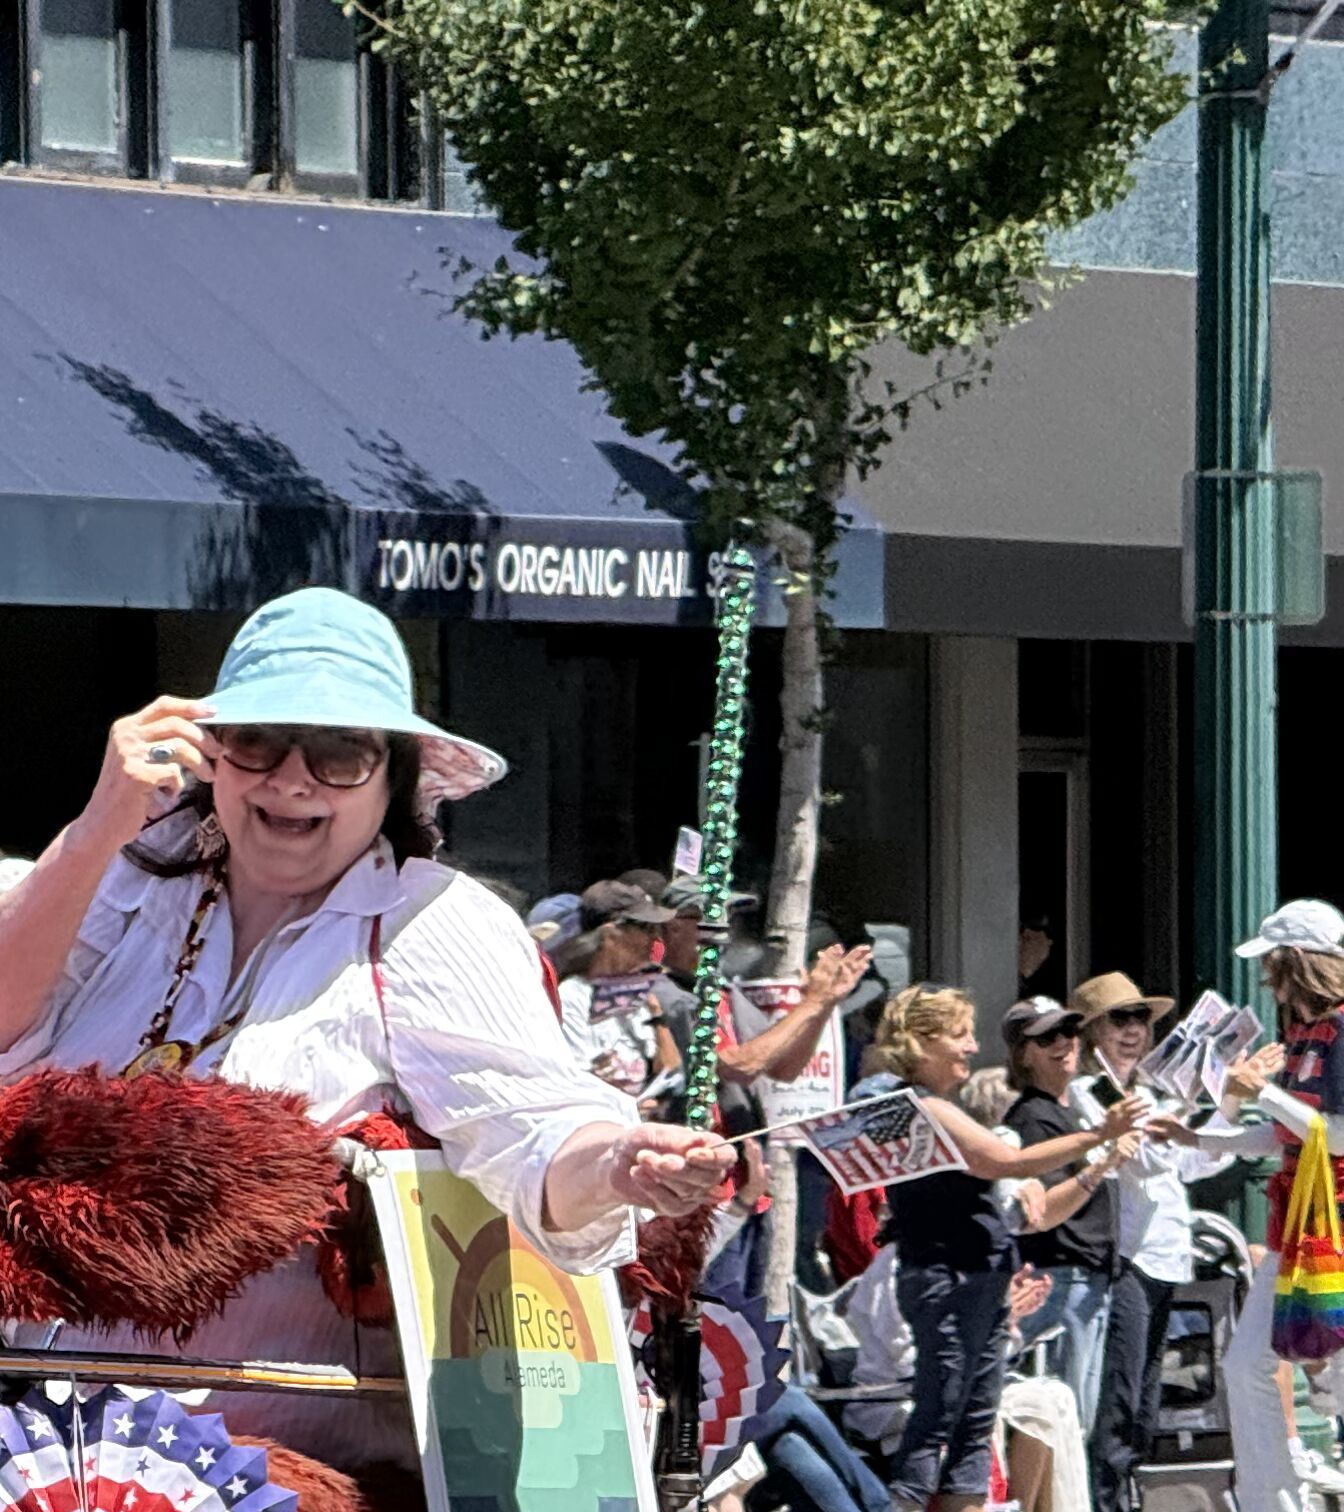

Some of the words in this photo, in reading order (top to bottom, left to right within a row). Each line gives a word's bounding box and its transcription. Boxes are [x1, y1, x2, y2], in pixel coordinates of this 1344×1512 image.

[378, 538, 485, 592] TOMO'S
[497, 543, 629, 597] ORGANIC
[637, 550, 695, 599] NAIL
[474, 1292, 509, 1349] All
[516, 1292, 578, 1352] Rise
[504, 1358, 567, 1390] Alameda
